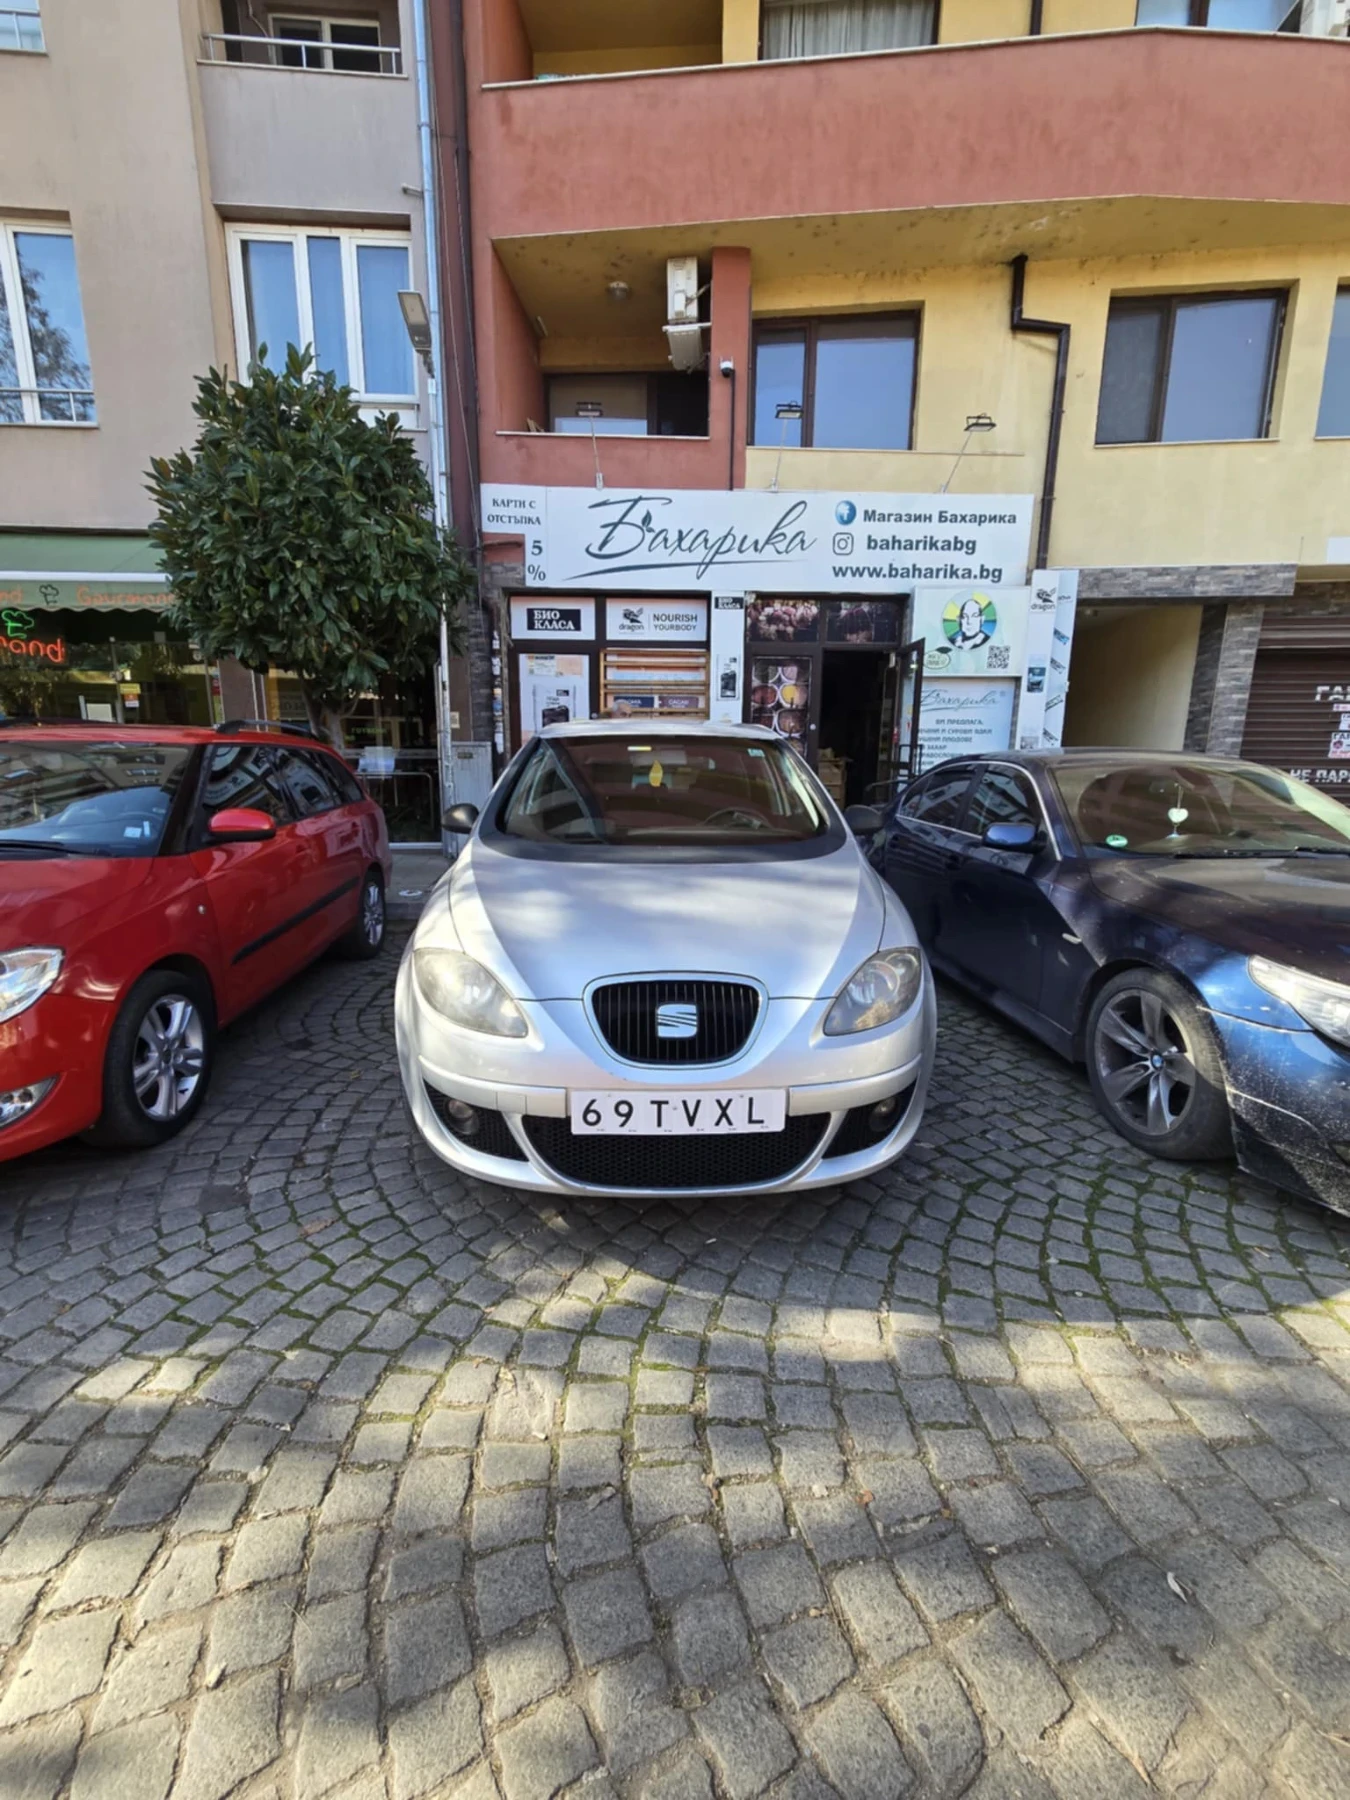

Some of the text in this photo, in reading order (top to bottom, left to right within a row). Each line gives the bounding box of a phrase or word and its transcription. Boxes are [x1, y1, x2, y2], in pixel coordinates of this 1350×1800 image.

[492, 498, 537, 509] КАРТИ С
[487, 514, 541, 526] ОТСТЪПКА
[863, 509, 1017, 526] Магазин Бахарика
[585, 495, 816, 580] Бахарика
[531, 540, 543, 556] 5
[867, 535, 977, 555] baharikabg
[527, 564, 546, 581] %
[832, 563, 1003, 584] www.baharika.bg
[77, 585, 176, 605] Gourman
[533, 610, 560, 620] БИО
[653, 613, 698, 623] NOURISH
[534, 620, 575, 630] КЛАСА
[618, 622, 645, 632] dragon
[653, 623, 697, 631] YOURBODY
[1315, 769, 1350, 783] ПАР
